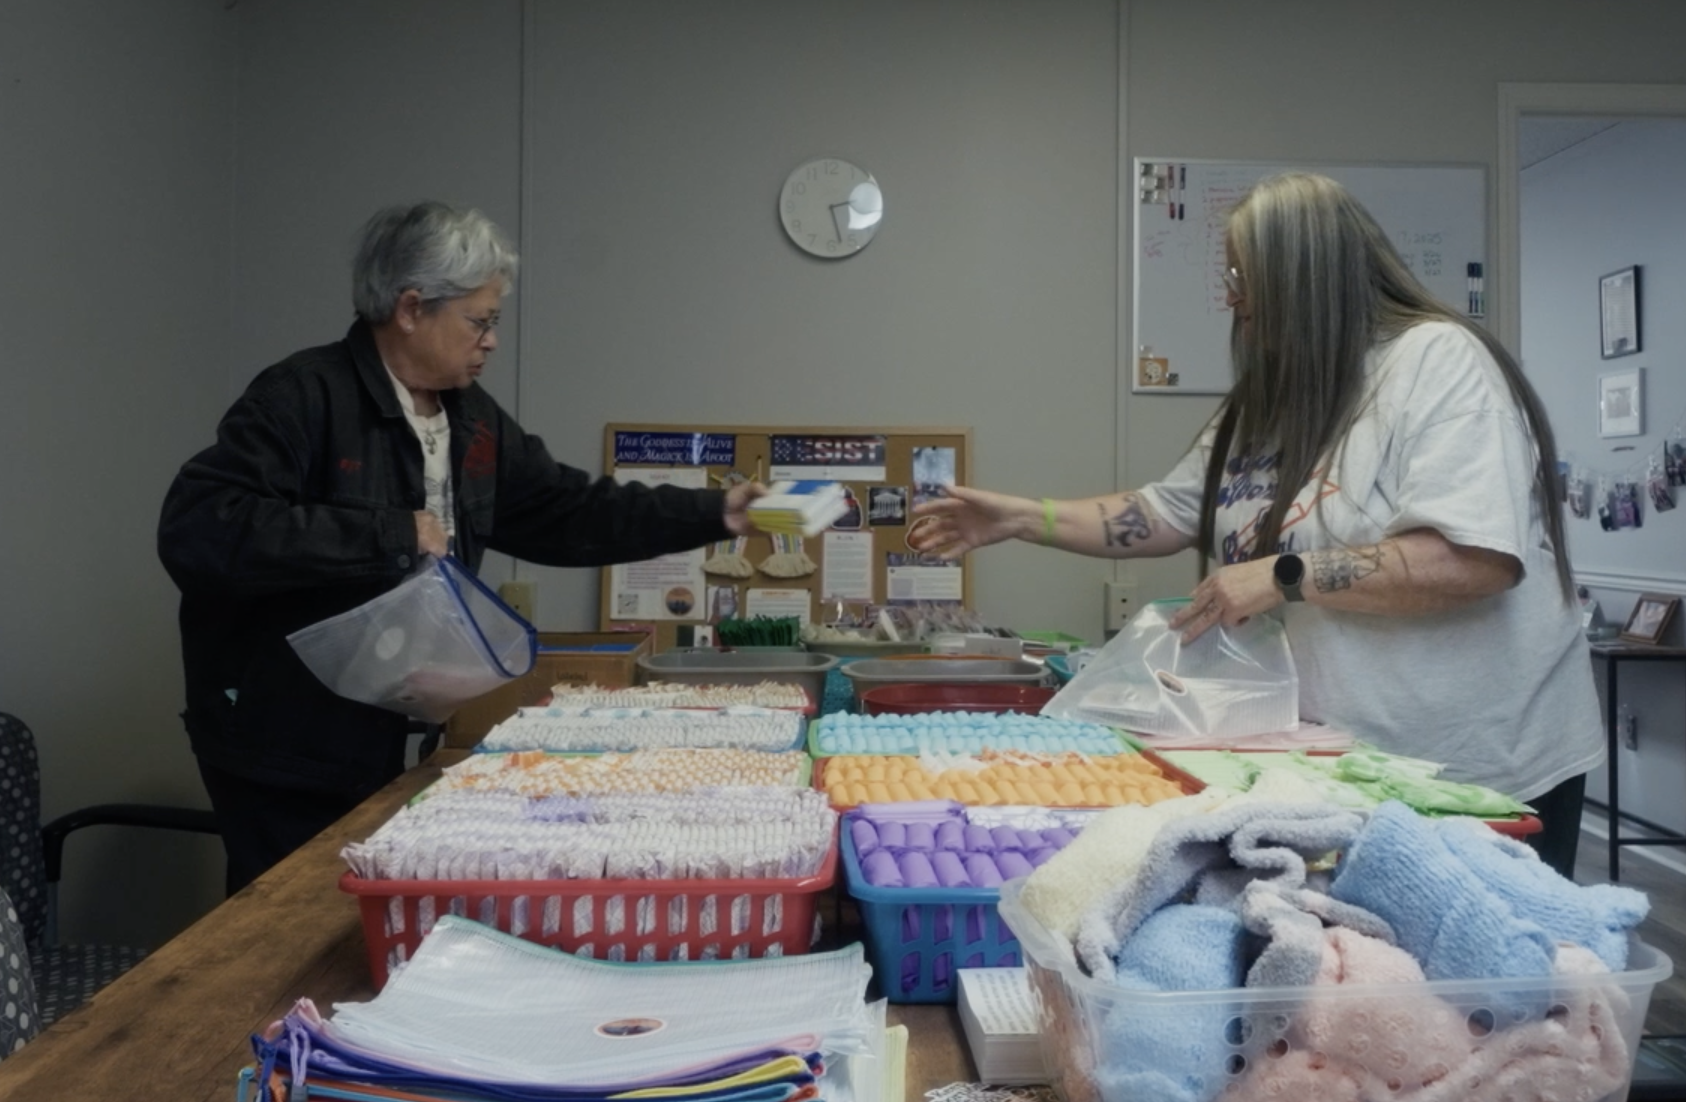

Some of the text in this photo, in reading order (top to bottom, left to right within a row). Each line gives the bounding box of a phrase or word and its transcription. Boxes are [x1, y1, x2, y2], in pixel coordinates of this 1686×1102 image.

[806, 167, 817, 180] 11
[823, 161, 839, 175] 12
[791, 182, 806, 195] 10
[785, 200, 794, 213] 9
[792, 220, 801, 233] 8
[807, 233, 817, 247] 7
[826, 239, 836, 252] 6
[848, 233, 857, 247] 5
[686, 438, 698, 448] I
[774, 438, 883, 462] RESIST
